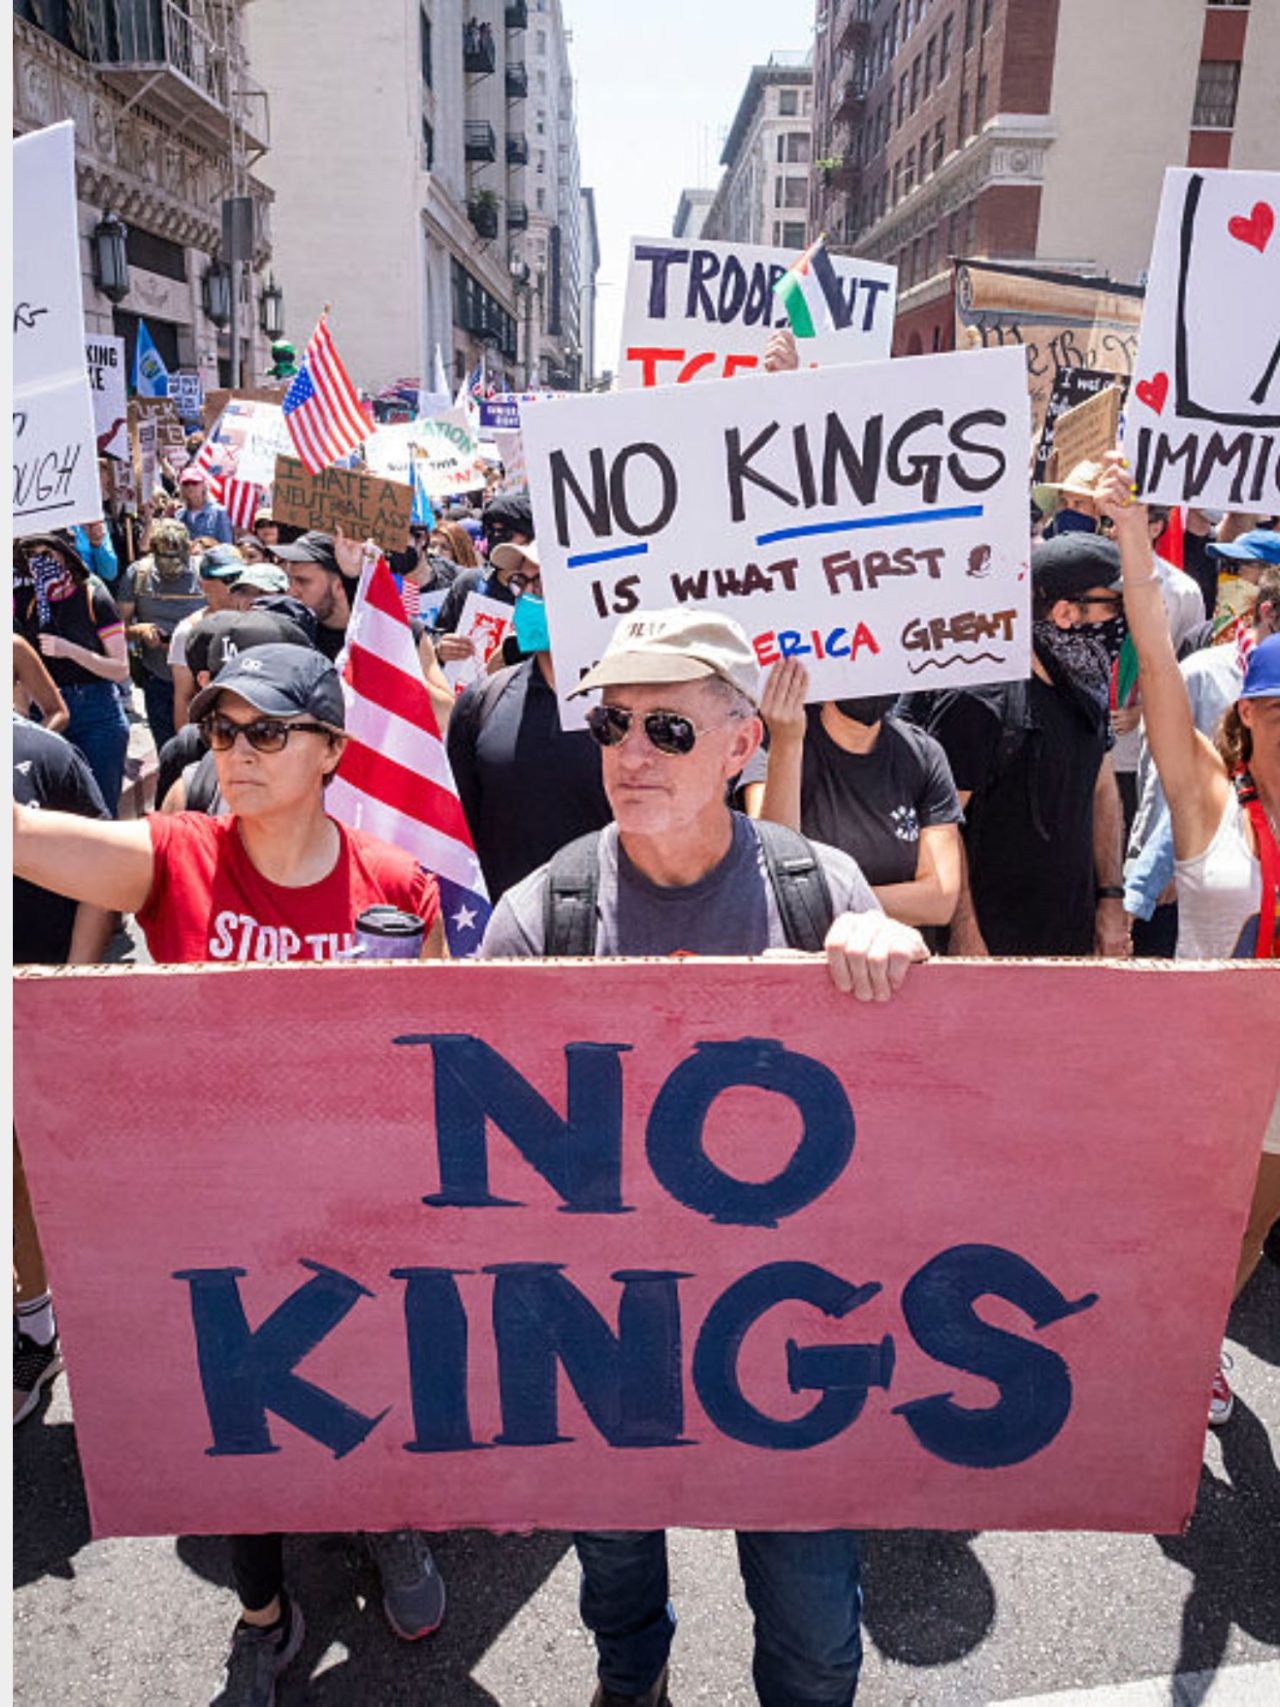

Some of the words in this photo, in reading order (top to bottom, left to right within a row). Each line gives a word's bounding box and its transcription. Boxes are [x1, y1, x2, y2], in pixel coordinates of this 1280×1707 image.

[312, 467, 370, 501] HATE
[379, 481, 399, 506] A
[550, 443, 678, 548] NO
[724, 408, 1007, 522] KINGS
[1135, 428, 1280, 503] IMMI
[591, 574, 641, 618] IS
[670, 558, 799, 603] WHAT
[822, 547, 946, 595] FIRST
[752, 621, 881, 667] ERICA
[901, 608, 1018, 652] GREAT
[209, 910, 302, 962] STOP
[392, 1033, 856, 1228] NO
[172, 1242, 1100, 1469] KINGS
